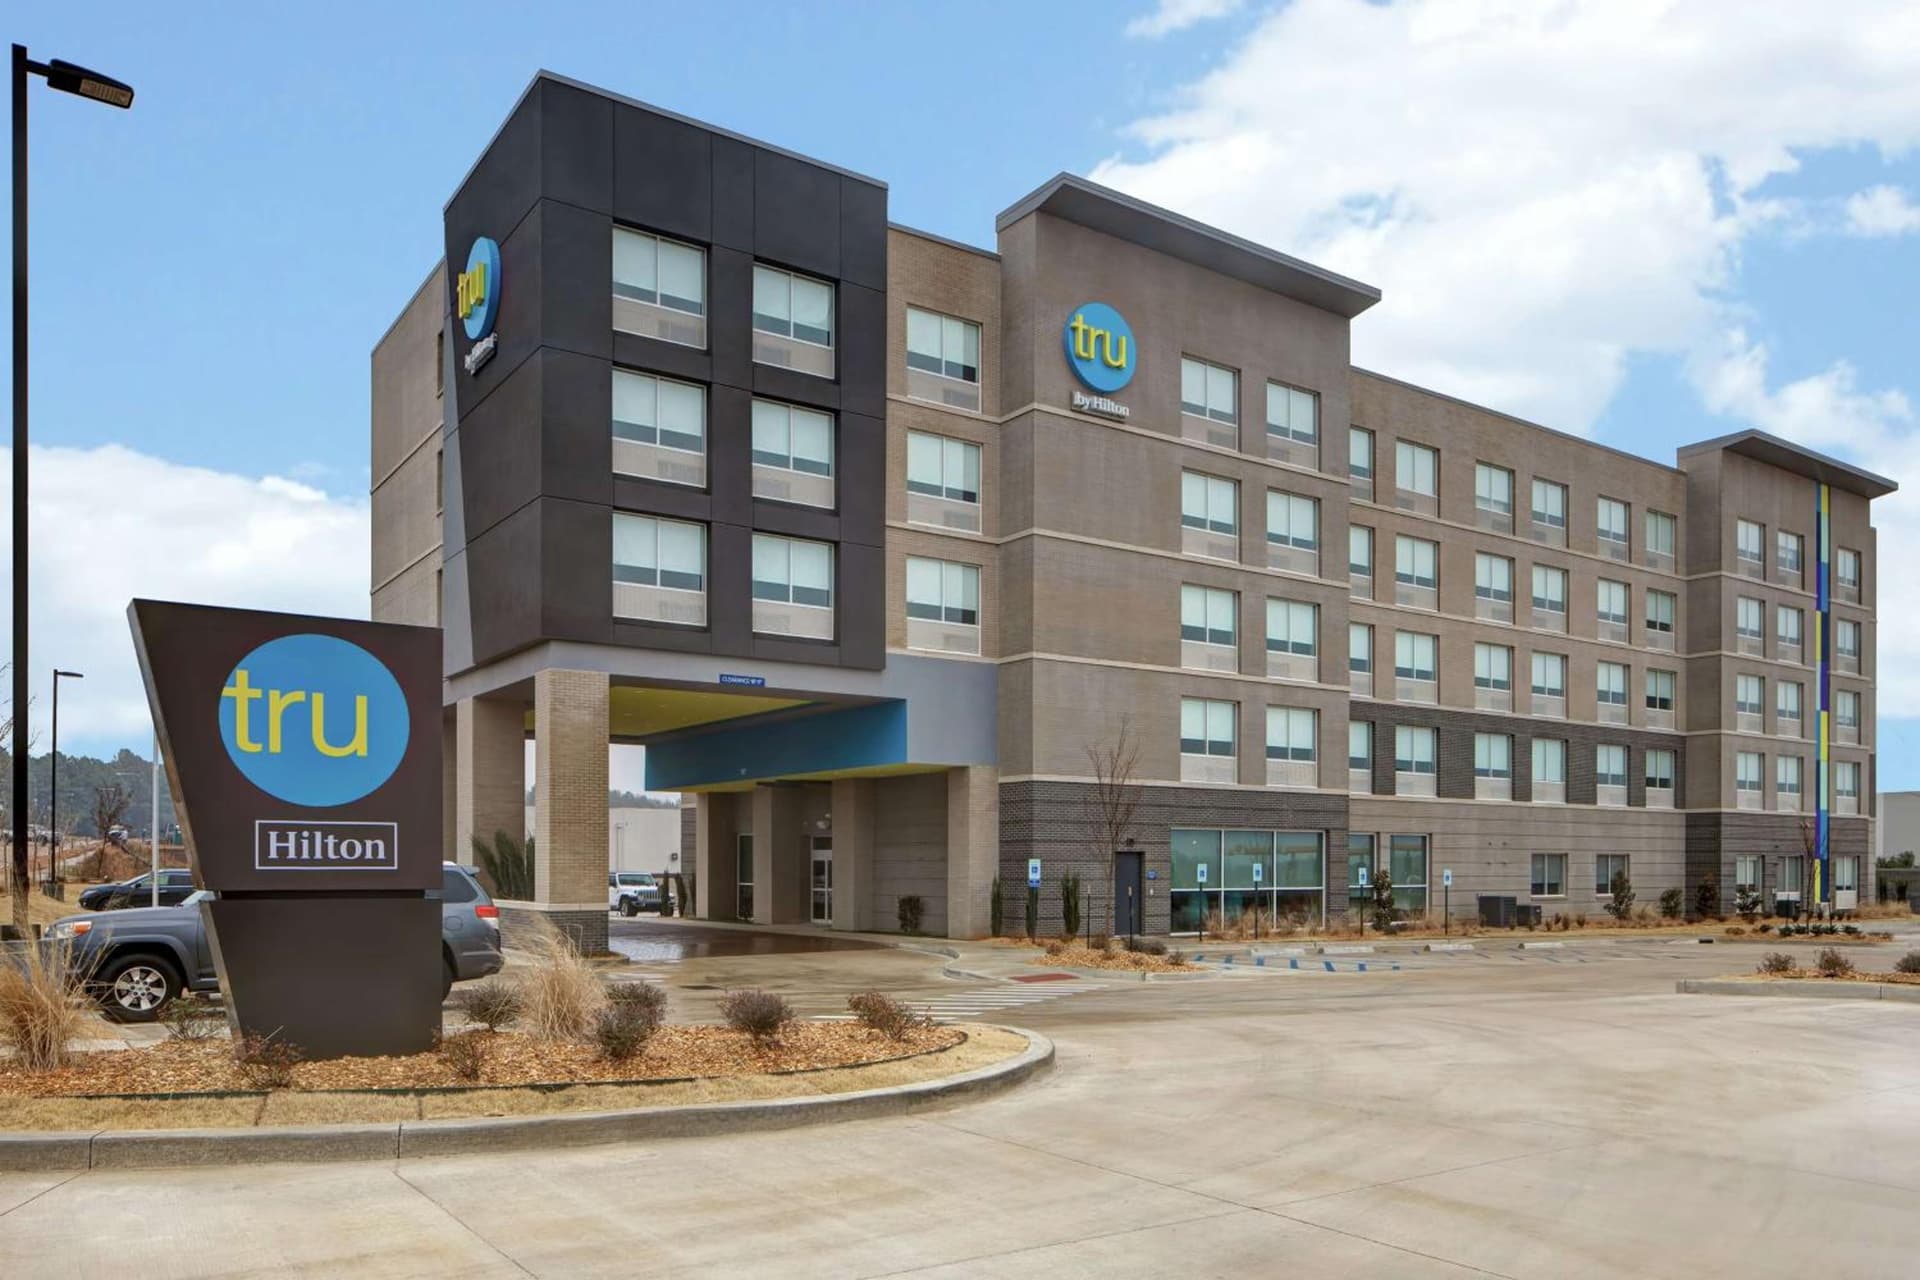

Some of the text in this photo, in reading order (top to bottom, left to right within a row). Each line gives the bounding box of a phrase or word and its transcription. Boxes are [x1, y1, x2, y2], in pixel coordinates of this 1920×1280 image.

[1071, 314, 1127, 368] tru
[1074, 391, 1130, 416] by Hilton
[221, 669, 369, 757] tru
[267, 830, 386, 860] Hilton
